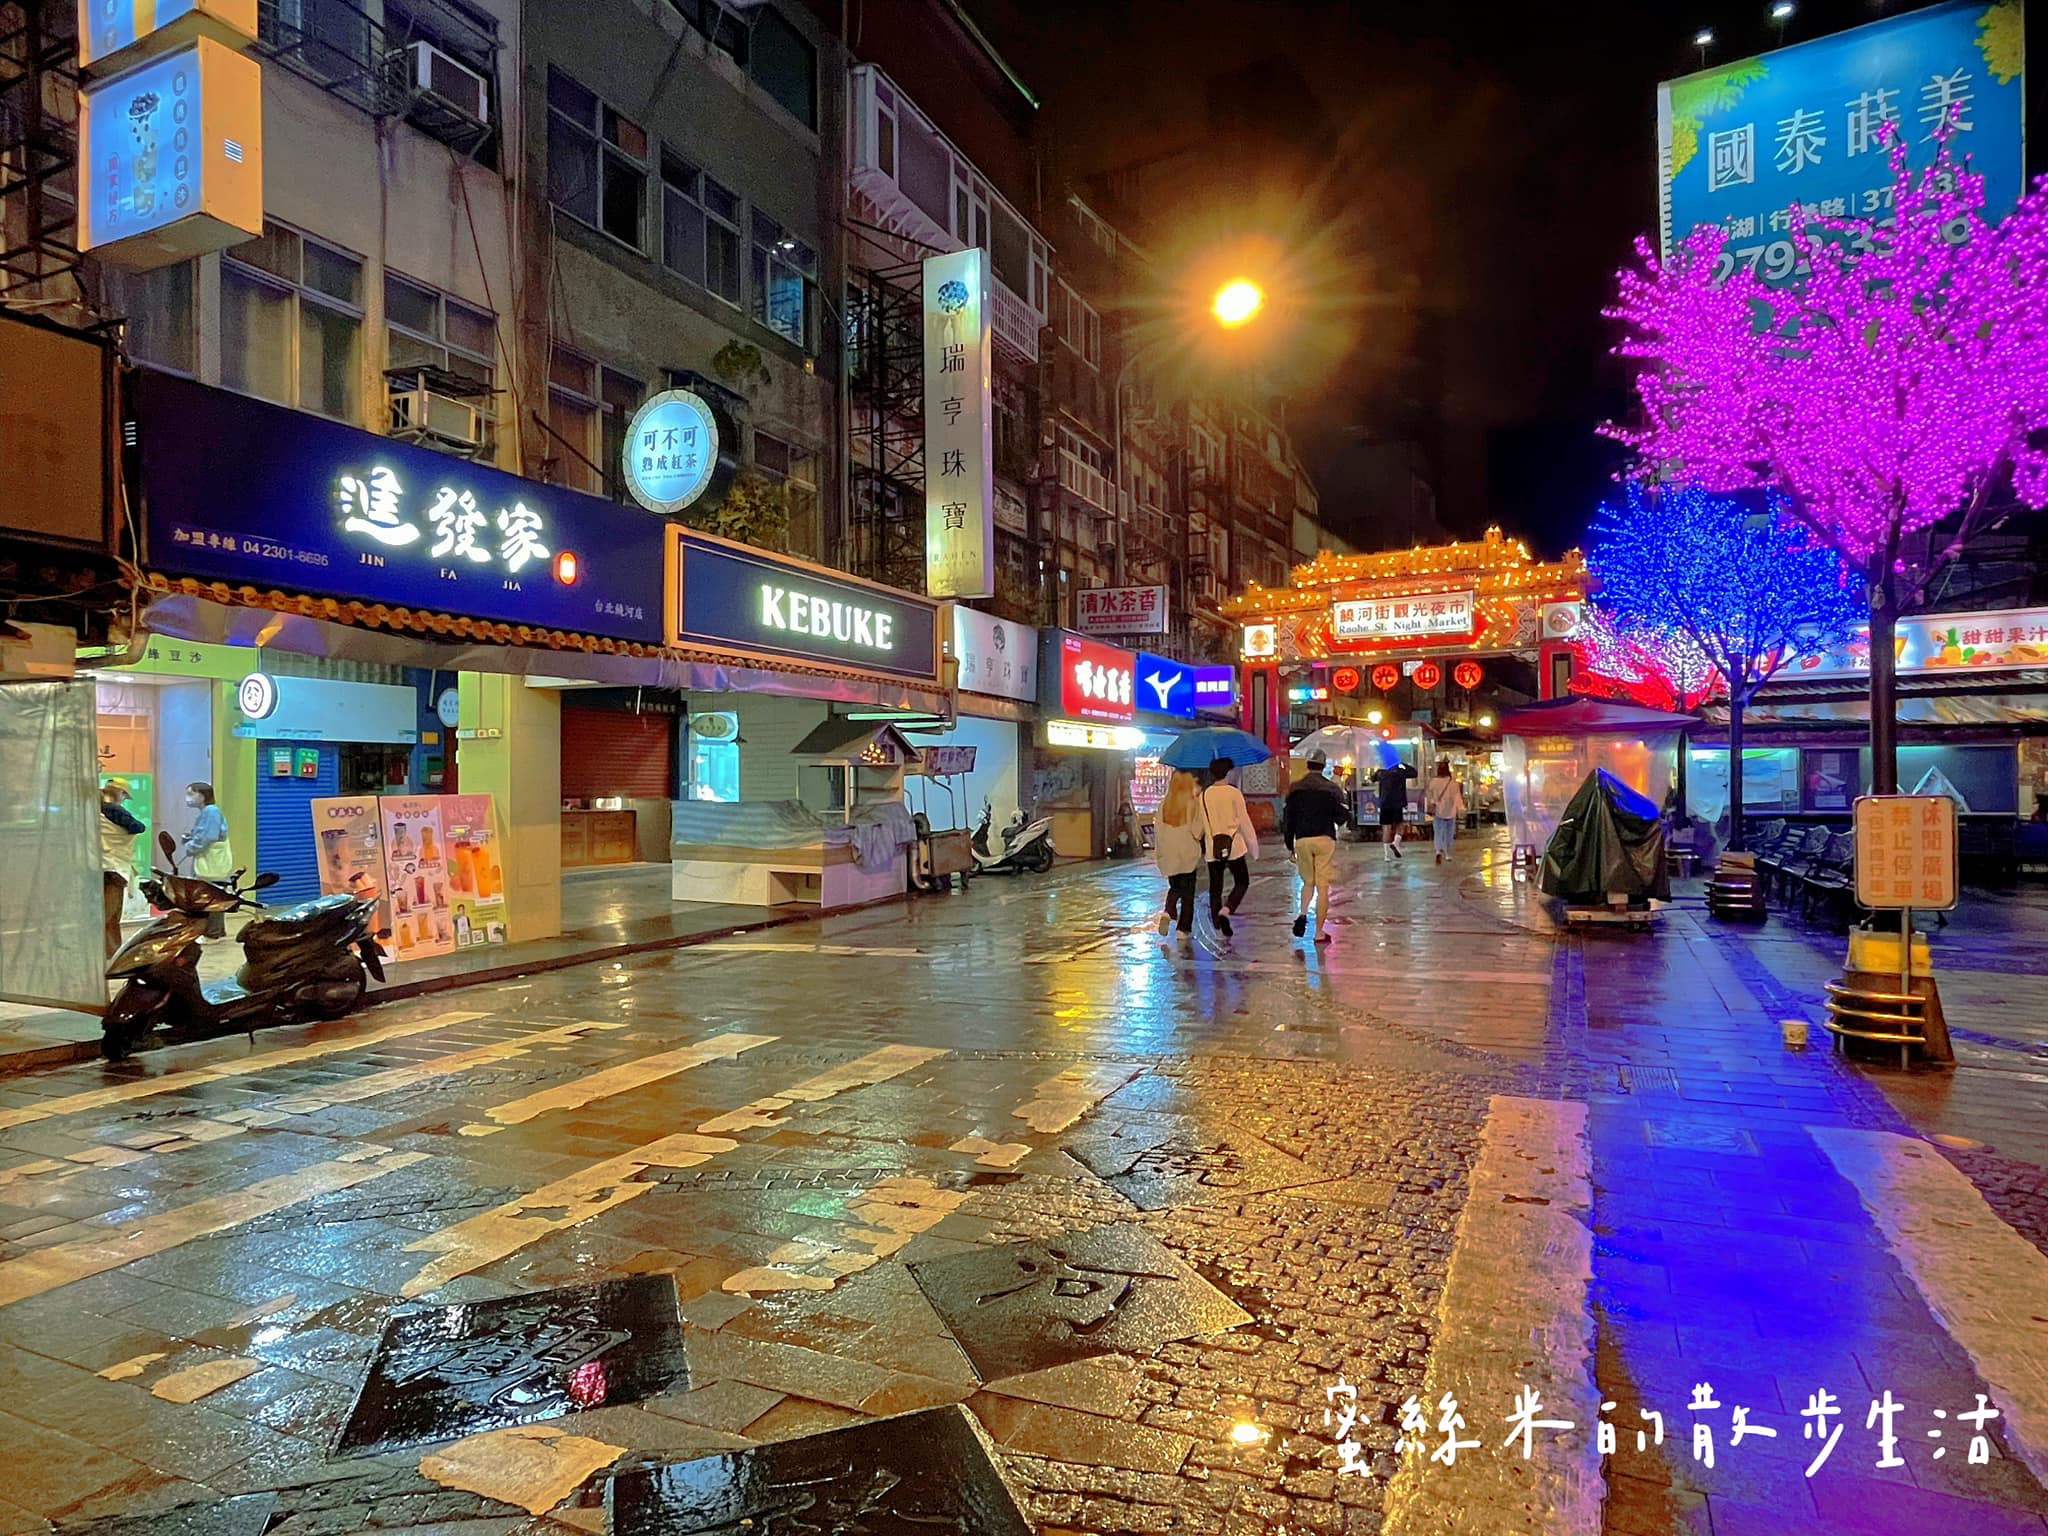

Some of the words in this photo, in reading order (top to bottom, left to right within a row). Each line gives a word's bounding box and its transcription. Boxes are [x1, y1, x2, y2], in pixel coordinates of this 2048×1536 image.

[1707, 67, 1975, 193] 國泰蒔美
[1706, 215, 1755, 241] 湖
[643, 425, 698, 452] 可不可
[940, 344, 967, 530] 瑞亨珠寶
[641, 453, 697, 473] 熟成紅茶
[341, 466, 550, 573] 進發家
[174, 527, 237, 552] 加盟專線
[243, 540, 259, 554] 04
[359, 553, 385, 567] JIN
[440, 567, 457, 580] FA
[502, 580, 522, 592] JIA
[1080, 589, 1157, 614] 清水茶香
[1340, 600, 1465, 623] 饒河街觀光夜市
[761, 584, 893, 650] KEBUKE
[1339, 625, 1368, 634] Raohe
[1375, 622, 1387, 632] St.
[1394, 620, 1421, 631] Night
[1428, 617, 1467, 628] Market
[1962, 625, 2048, 645] 甜甜果汁
[1892, 805, 1912, 899] 禁止停車
